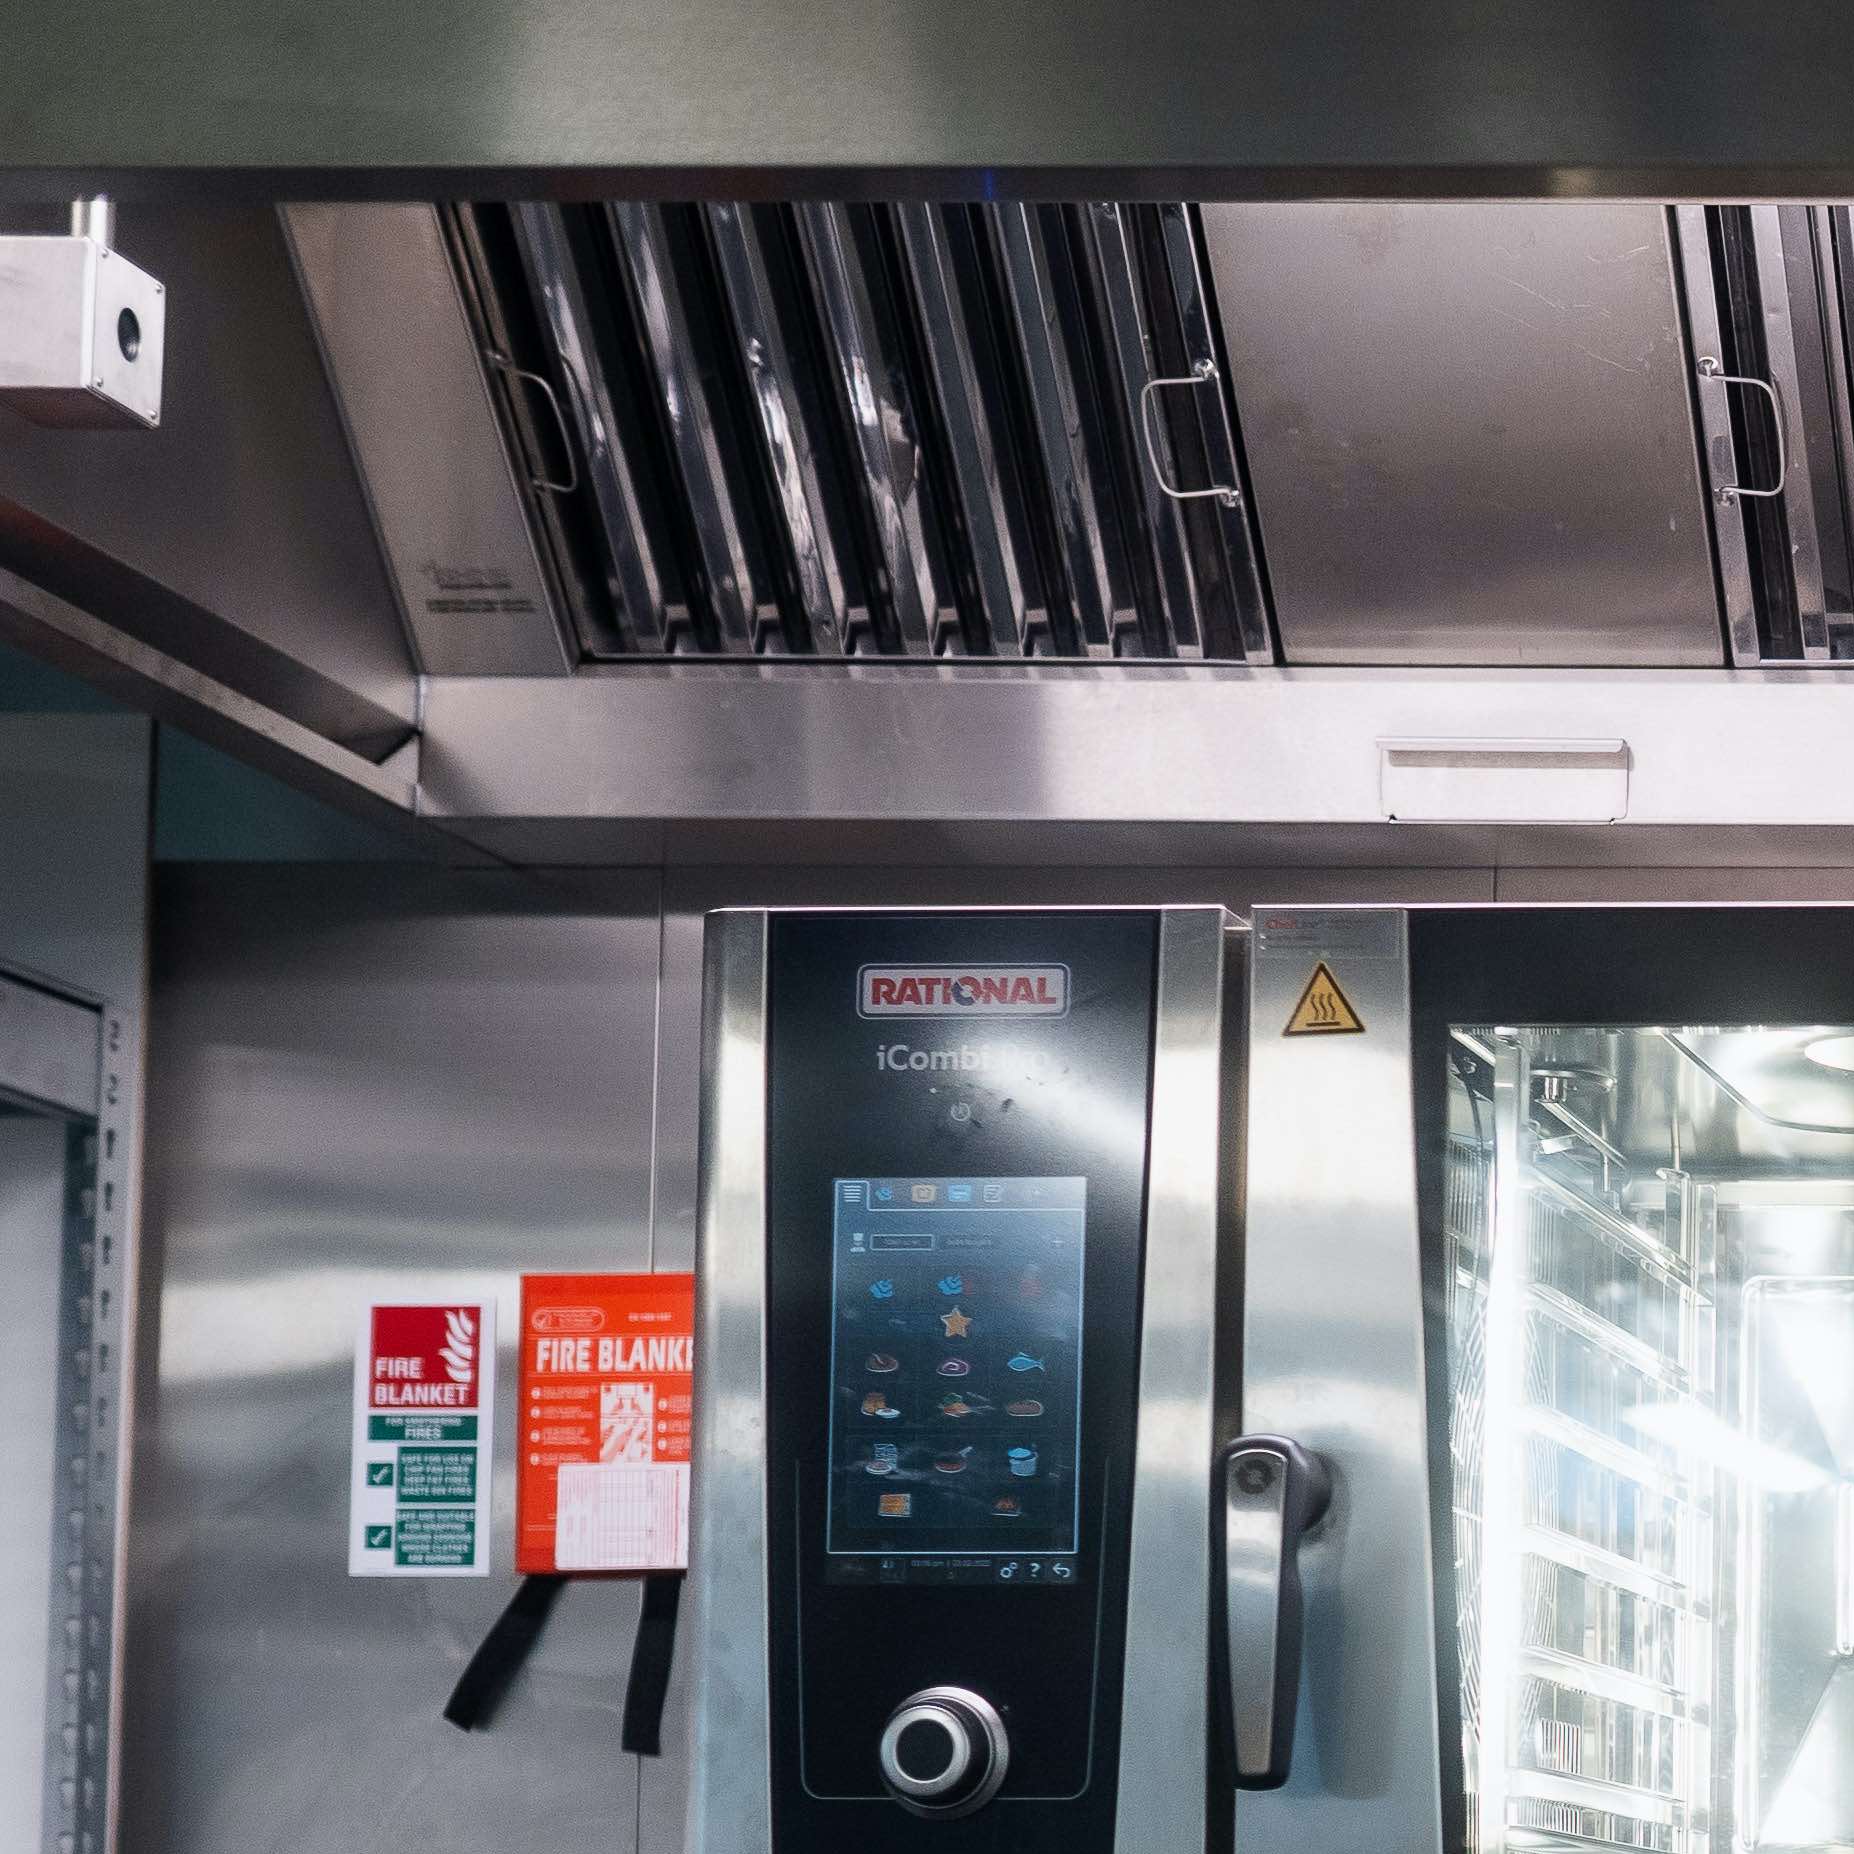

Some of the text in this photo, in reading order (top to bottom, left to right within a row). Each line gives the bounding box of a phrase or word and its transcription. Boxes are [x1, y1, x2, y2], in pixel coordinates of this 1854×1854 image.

[871, 975, 1057, 1006] RATIONAL
[876, 1044, 988, 1071] iCombi
[536, 1338, 591, 1373] FIRE
[375, 1357, 424, 1379] FIRE
[375, 1383, 470, 1405] BLANKET
[404, 1428, 442, 1440] FIRES
